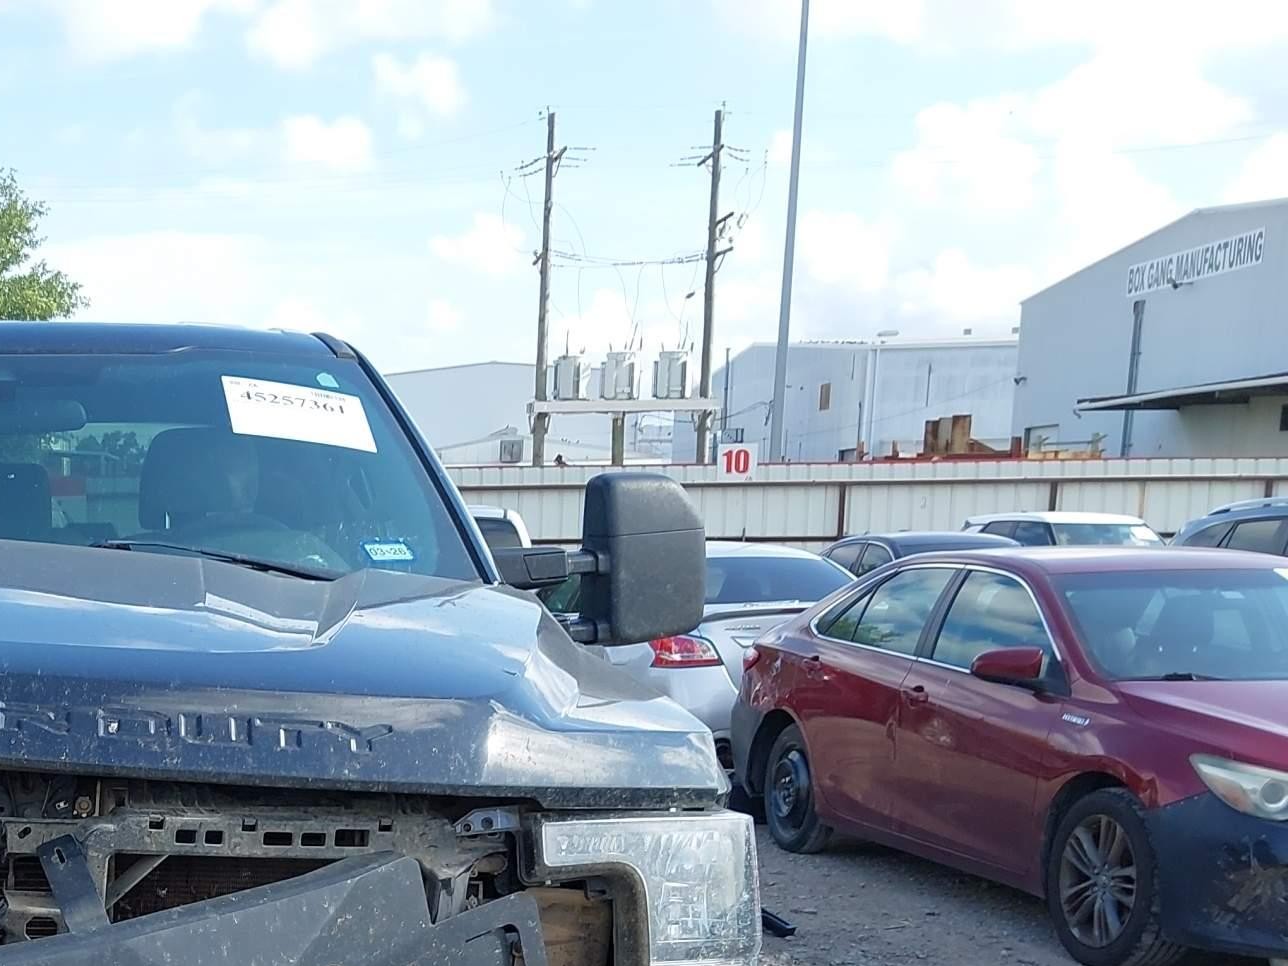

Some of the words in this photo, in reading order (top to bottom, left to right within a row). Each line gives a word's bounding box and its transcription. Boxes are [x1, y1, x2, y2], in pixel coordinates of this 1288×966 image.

[1128, 263, 1146, 295] BOX
[1147, 257, 1174, 289] GANG
[1174, 231, 1264, 282] MANUFACTURING
[240, 390, 345, 415] 45257361
[722, 449, 750, 474] 10
[96, 703, 394, 752] DUTY
